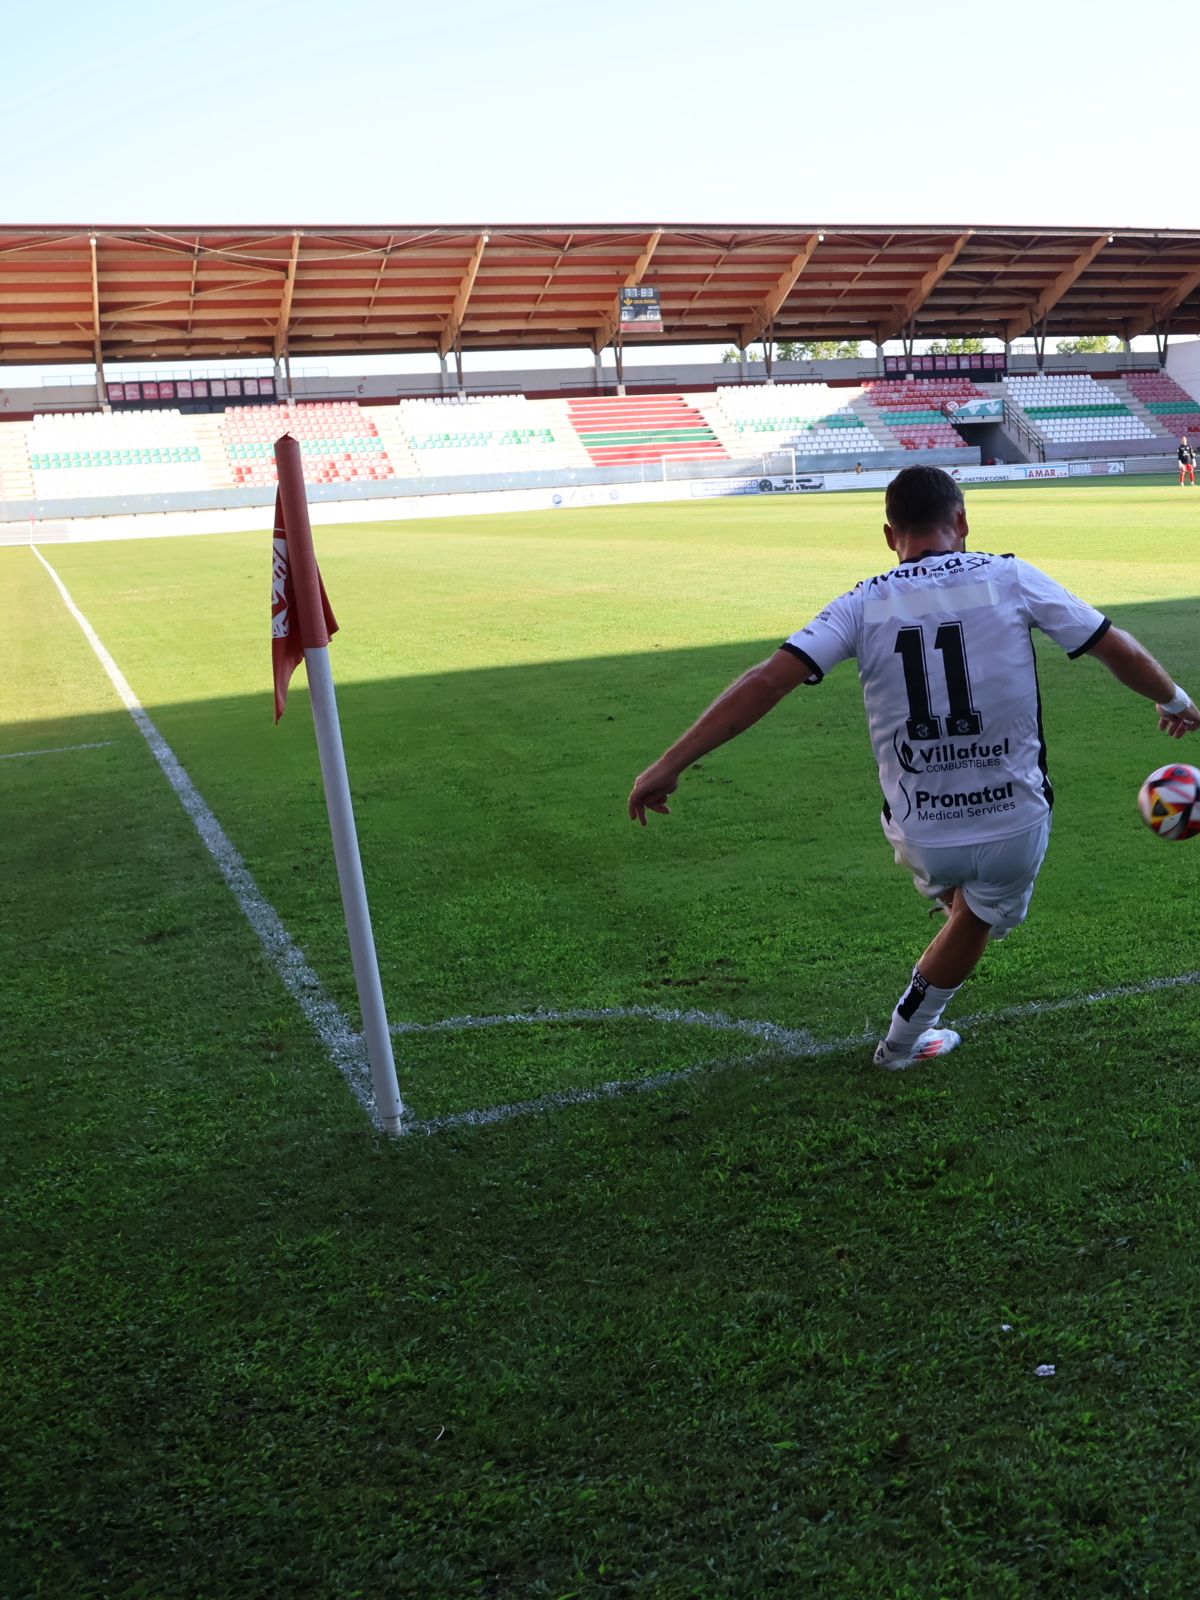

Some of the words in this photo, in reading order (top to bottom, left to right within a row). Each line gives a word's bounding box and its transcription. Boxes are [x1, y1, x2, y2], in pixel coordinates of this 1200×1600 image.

[894, 621, 983, 740] 11
[920, 738, 1009, 763] Villafuel
[926, 758, 1001, 773] COMBUSTIBLES
[915, 782, 1013, 808] Pronatal
[918, 808, 964, 820] Medical
[967, 801, 1016, 817] Services
